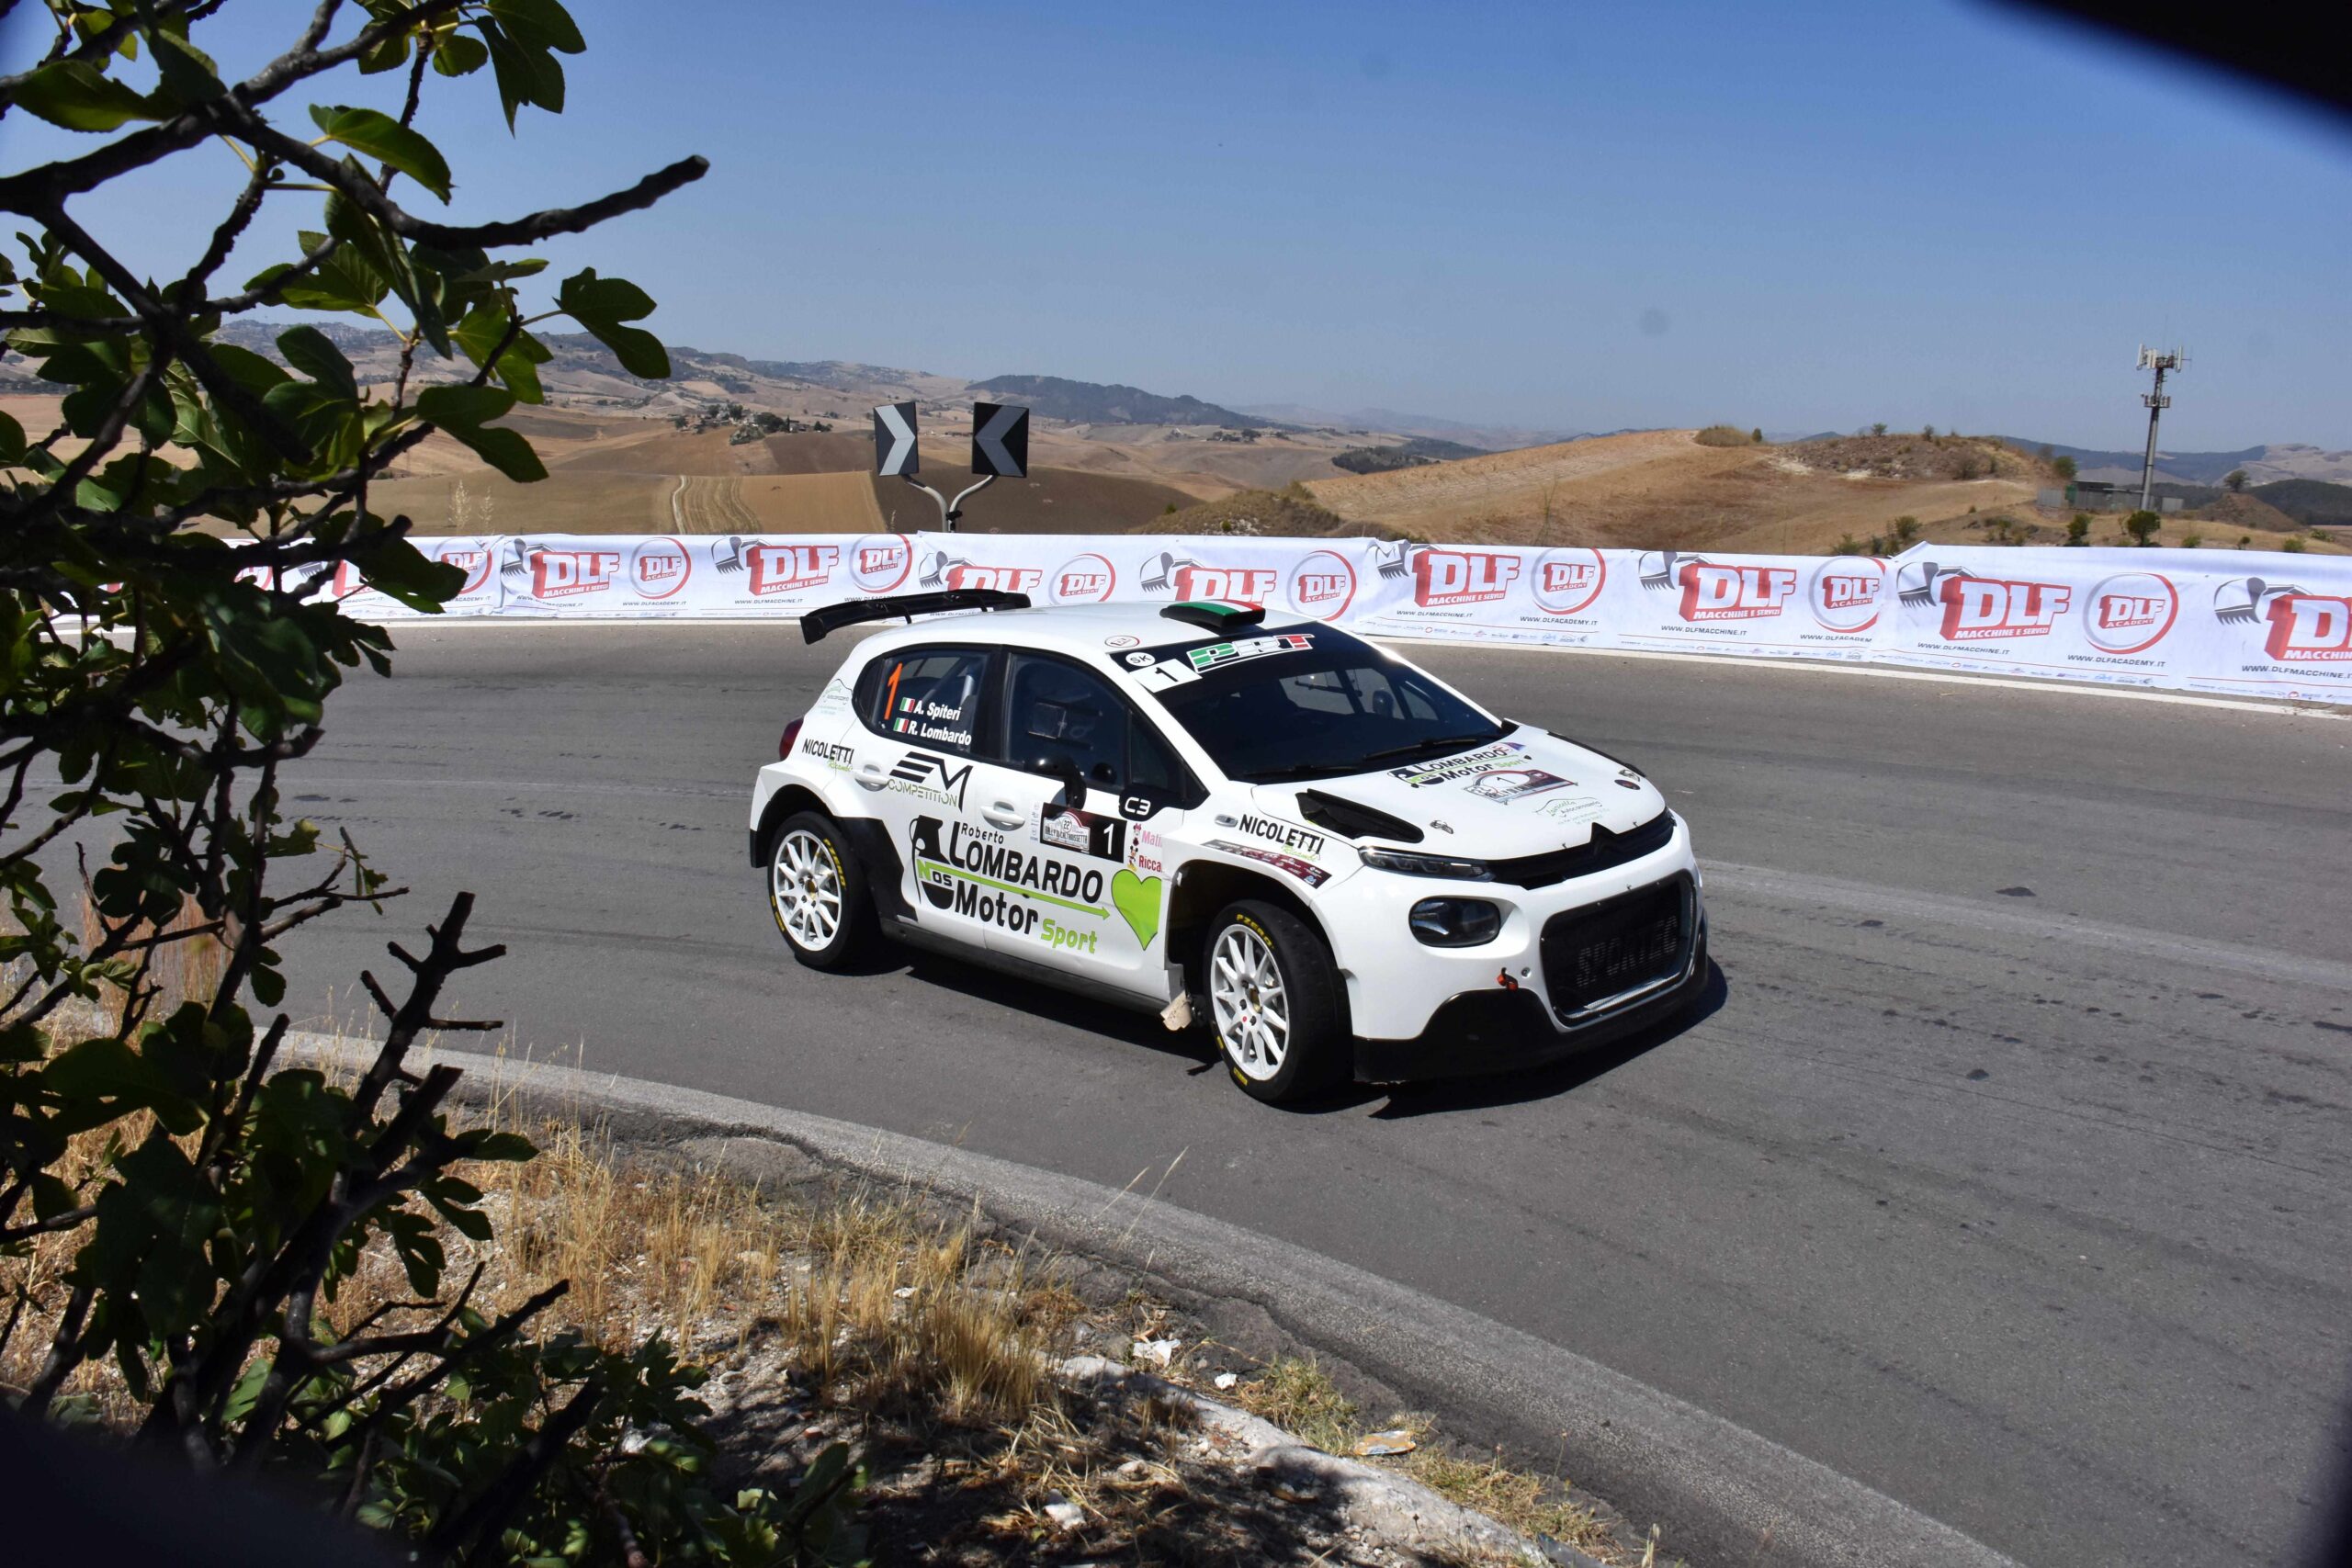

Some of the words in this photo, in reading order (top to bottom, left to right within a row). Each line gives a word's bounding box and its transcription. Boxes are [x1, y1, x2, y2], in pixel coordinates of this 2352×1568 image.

[643, 556, 683, 576] DLF
[759, 547, 840, 585] DLF
[866, 548, 903, 568] DLF
[542, 552, 620, 590] DLF
[1427, 553, 1521, 596] DLF
[1549, 564, 1596, 585] DLF
[543, 585, 586, 599] MACCHINE
[760, 580, 805, 594] MACCHINE
[1068, 574, 1107, 594] DLF
[1190, 569, 1277, 605] DLF
[1306, 575, 1347, 597] DLF
[1696, 566, 1797, 610] DLF
[1829, 578, 1881, 602] DLF
[1426, 592, 1477, 606] MACCHINE
[1959, 581, 2073, 629] DLF
[2108, 596, 2166, 624] DLF
[1519, 615, 1599, 626] WWW.DLFACADEMY.IT
[1692, 609, 1749, 620] MACCHINE
[1660, 624, 1747, 637] WWW.DLFMACCHINE.IT
[1799, 633, 1873, 643] WWW.DLFACADEM
[1953, 626, 2016, 640] MACCHINE
[1129, 654, 1152, 665] SK
[1917, 641, 2011, 656] WWW.DLFMACCHINE.IT
[2282, 649, 2352, 660] MACCHIN
[2066, 654, 2166, 669] WWW.DLFACADEMY.IT
[1154, 666, 1180, 683] 1
[884, 662, 904, 721] 1
[912, 700, 924, 716] A.
[926, 702, 962, 722] Spiteri
[907, 720, 919, 736] R.
[920, 723, 973, 746] Lombardo
[801, 738, 855, 764] NICOLETTI
[1413, 748, 1509, 773] LOMBARDO
[1438, 762, 1496, 781] Motor
[888, 778, 958, 807] COMPETITION
[1124, 795, 1152, 817] C3
[961, 822, 1005, 845] Roberto
[1103, 823, 1114, 855] 1
[1238, 814, 1326, 855] NICOLETTI
[949, 820, 1103, 904] LOMBARDO
[1138, 854, 1163, 873] Ricca
[954, 878, 1039, 935] Motor
[1040, 918, 1099, 954] Sport
